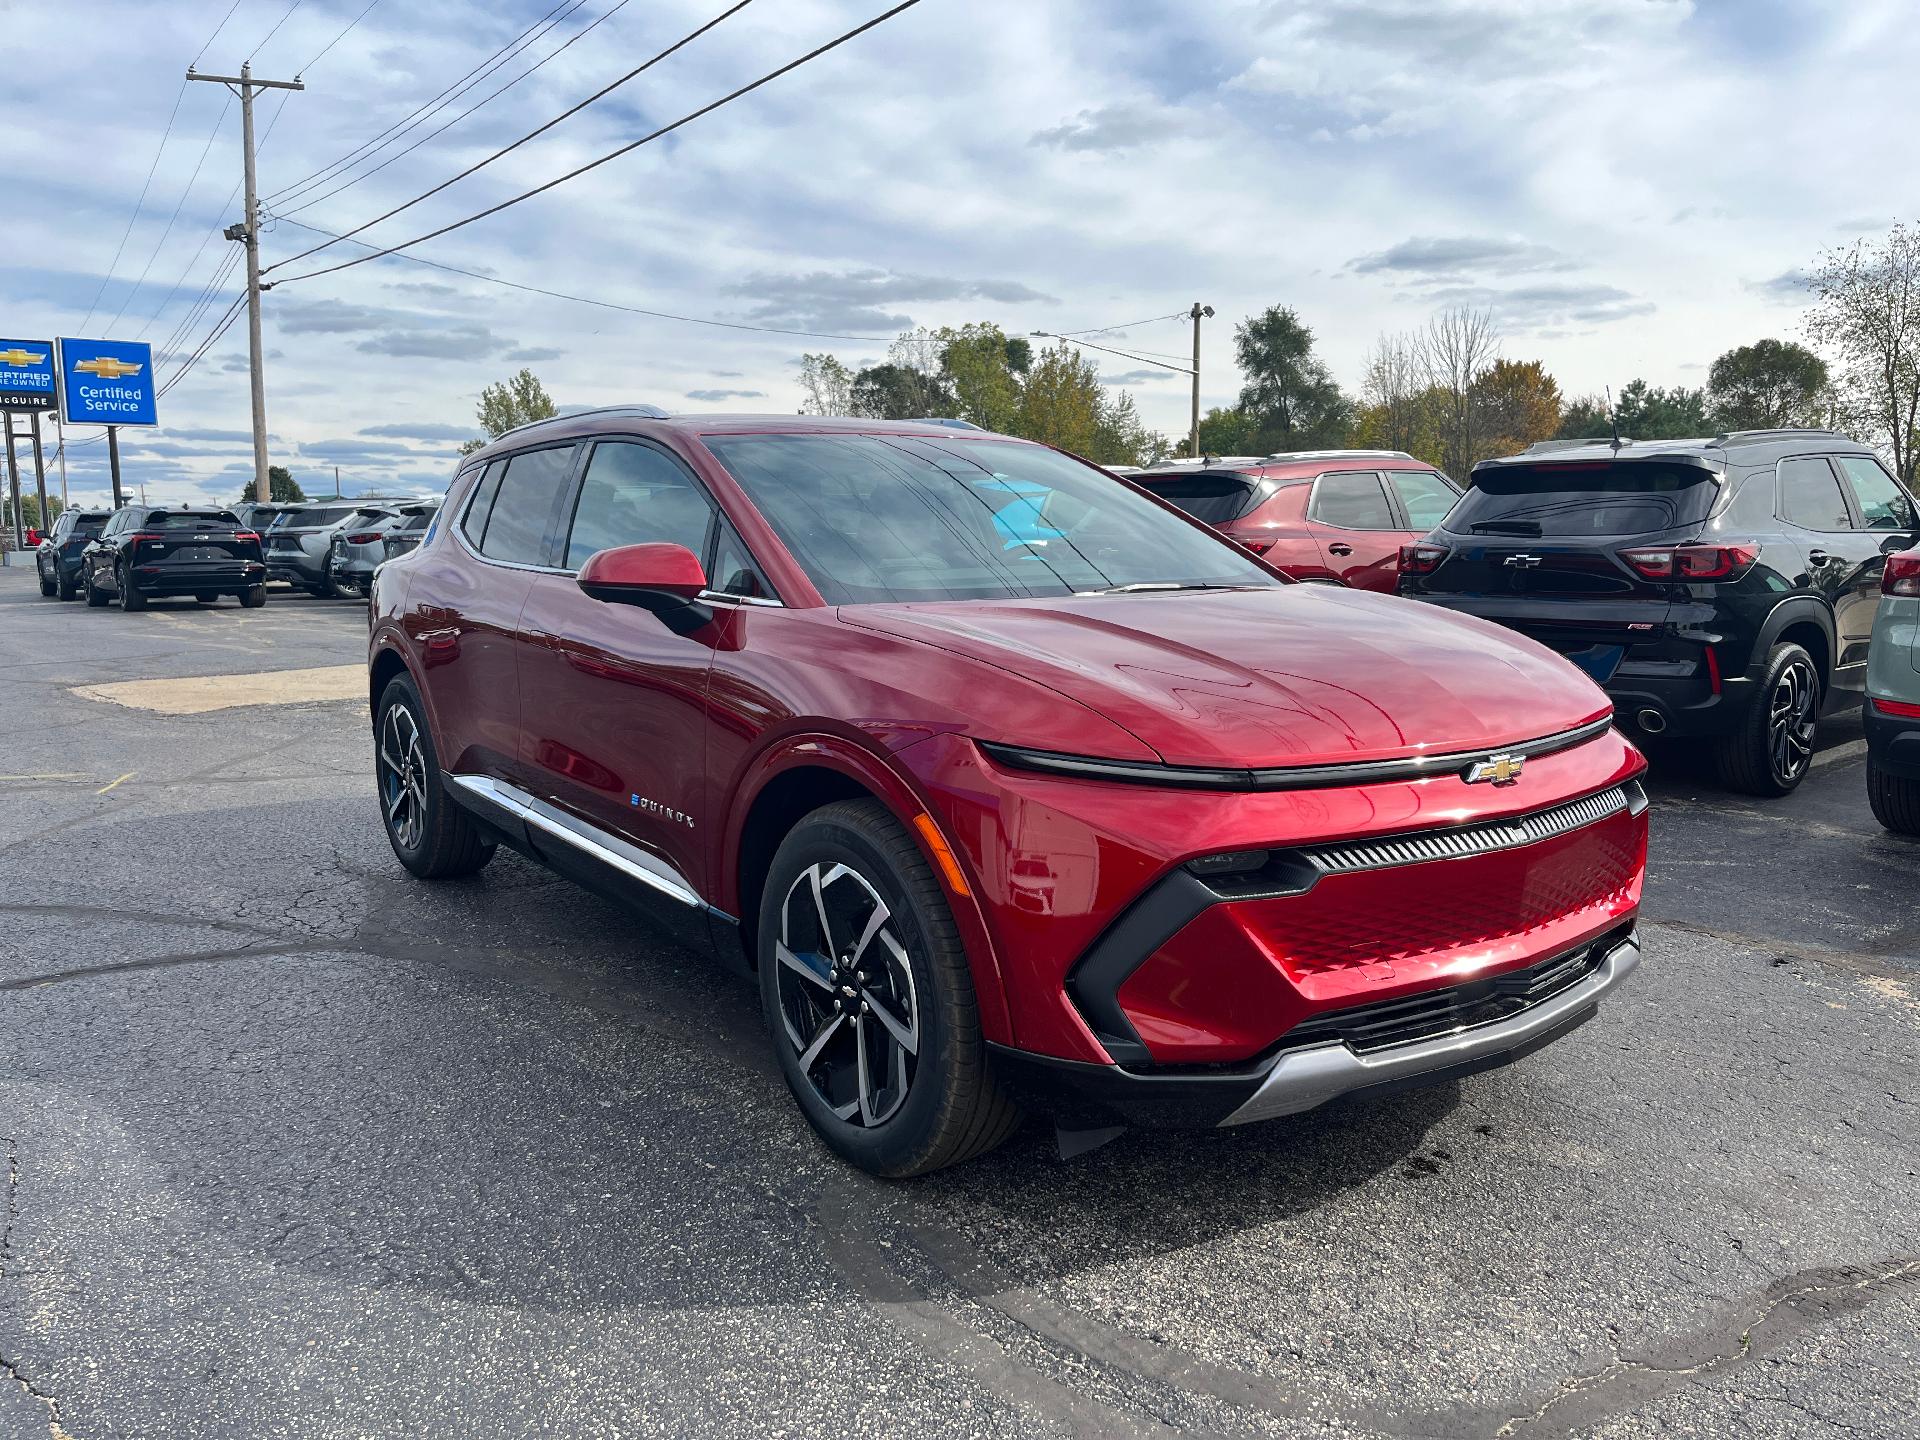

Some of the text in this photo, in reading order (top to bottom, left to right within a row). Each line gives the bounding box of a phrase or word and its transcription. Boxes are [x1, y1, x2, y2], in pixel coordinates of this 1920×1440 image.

[79, 386, 141, 400] Certified
[0, 396, 47, 406] cGUIRE
[85, 399, 139, 412] Service
[631, 793, 695, 828] EQUINOX
